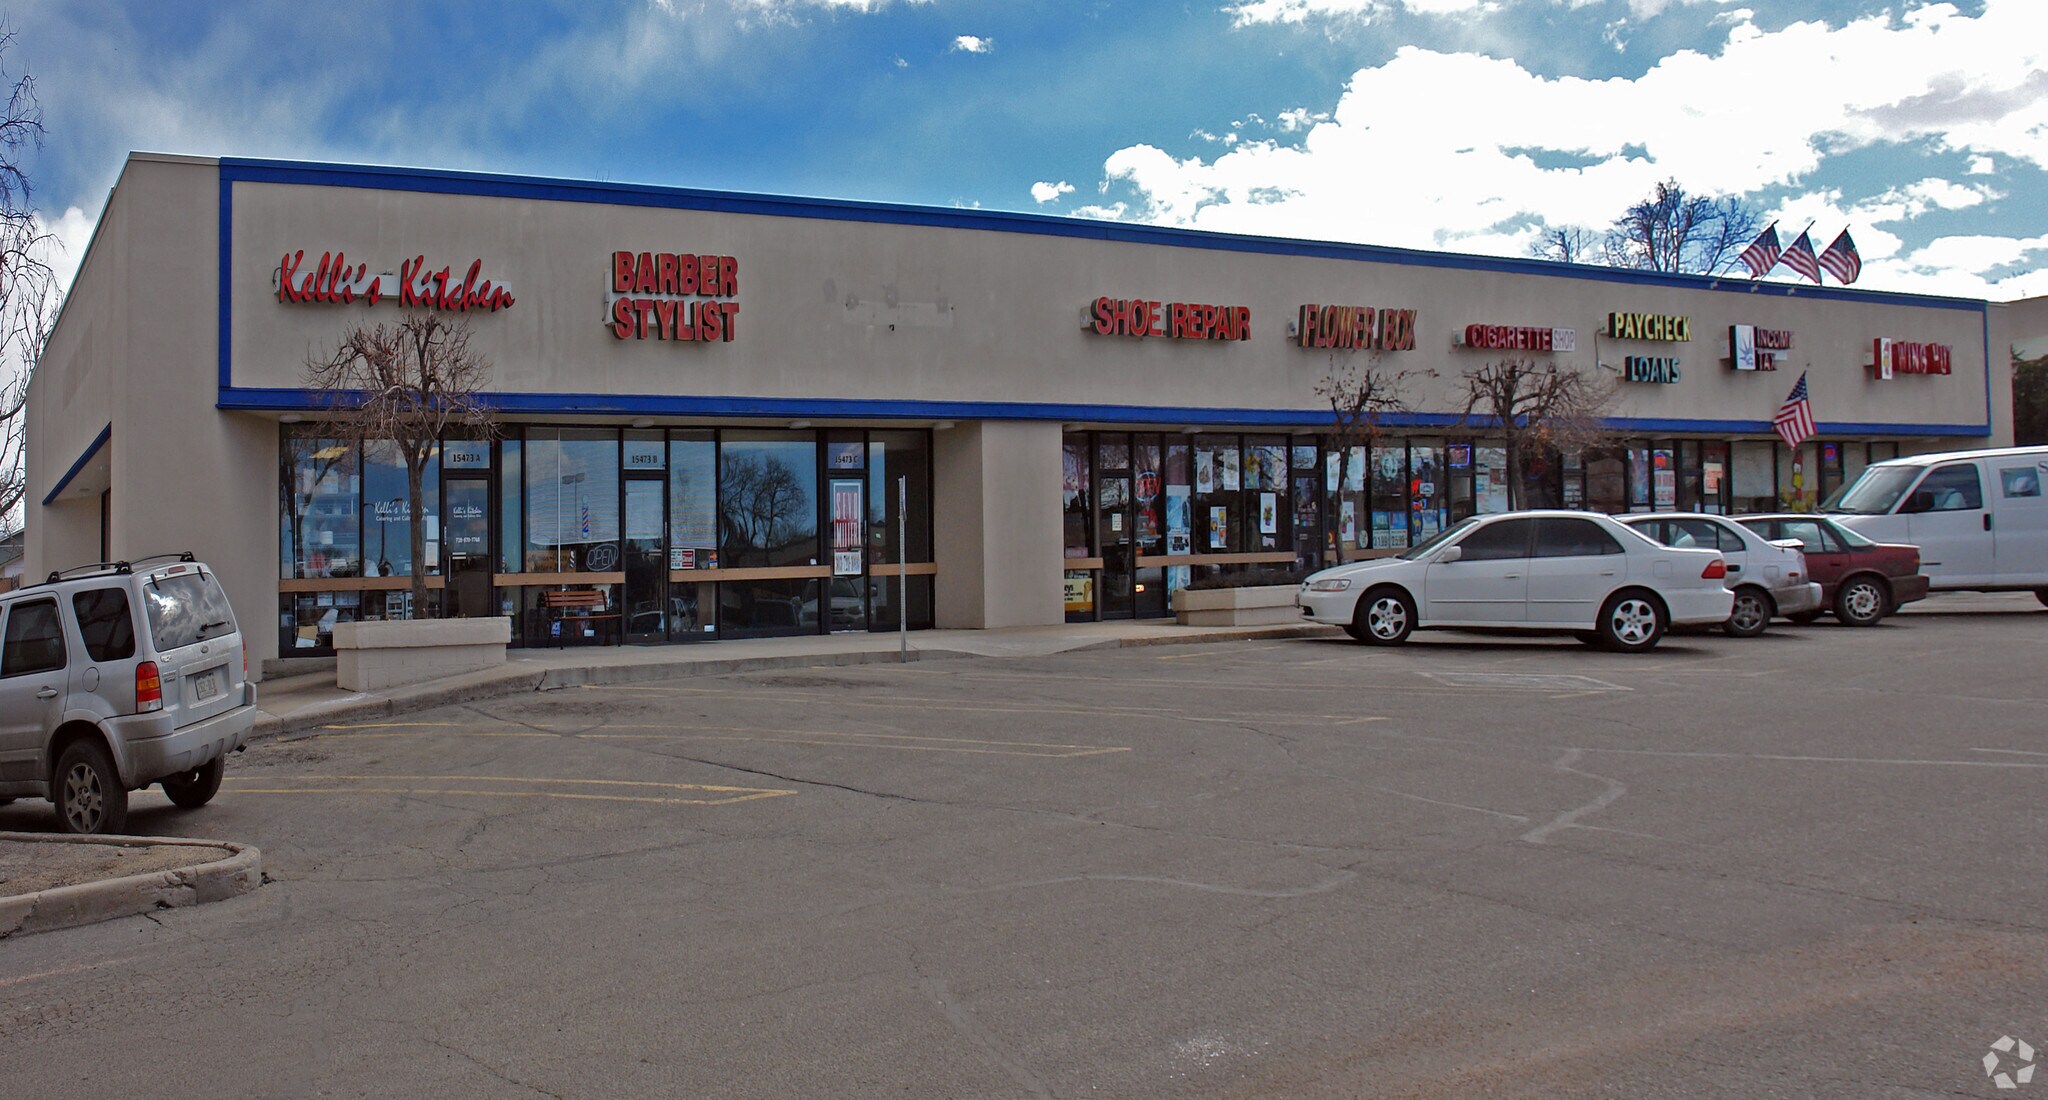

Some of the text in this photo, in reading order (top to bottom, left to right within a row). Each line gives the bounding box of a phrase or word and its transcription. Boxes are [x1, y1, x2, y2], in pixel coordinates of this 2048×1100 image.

[278, 250, 515, 312] Kelli's Kitchen
[611, 250, 739, 296] BARBER
[611, 297, 740, 342] STYLIST
[1092, 297, 1251, 341] SHOE REPAIR
[1299, 304, 1417, 351] FLOWER BOX
[1609, 311, 1692, 342] PAYCHECK
[1466, 324, 1576, 352] CIGARETTE SHOP
[1626, 354, 1682, 384] LOANS
[453, 453, 481, 463] 15473 A
[631, 455, 651, 464] 15473
[853, 455, 858, 464] C
[374, 501, 398, 514] Kelli's
[588, 548, 618, 567] OPEN
